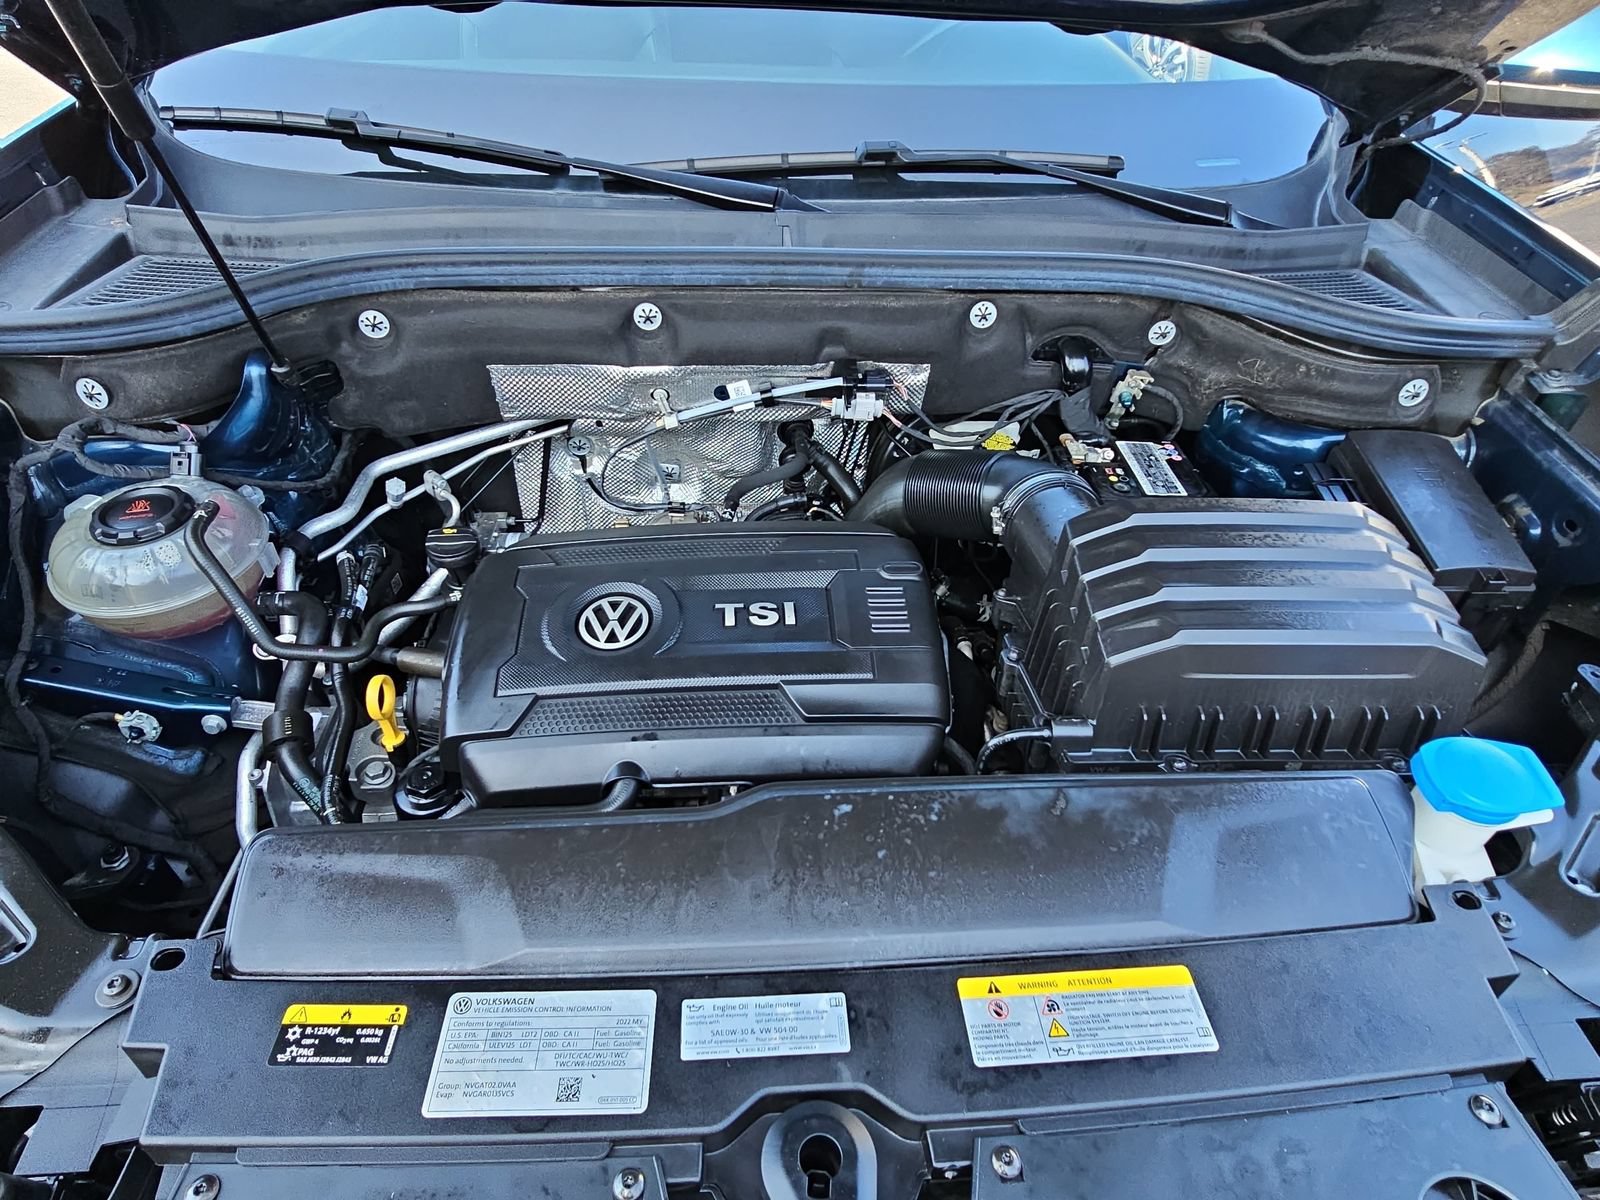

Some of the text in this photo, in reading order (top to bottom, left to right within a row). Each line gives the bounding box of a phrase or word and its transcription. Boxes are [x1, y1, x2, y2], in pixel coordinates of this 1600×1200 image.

[714, 601, 797, 627] TSI
[1018, 977, 1112, 990] WARNING ATTENTION
[476, 998, 536, 1006] VOLKSWAGEN
[713, 1004, 736, 1012] Engine
[305, 1026, 341, 1036] R-1234yf
[374, 1028, 384, 1036] kg
[297, 1048, 315, 1056] PAG
[455, 1056, 498, 1066] adjustments
[438, 1082, 461, 1090] Group:
